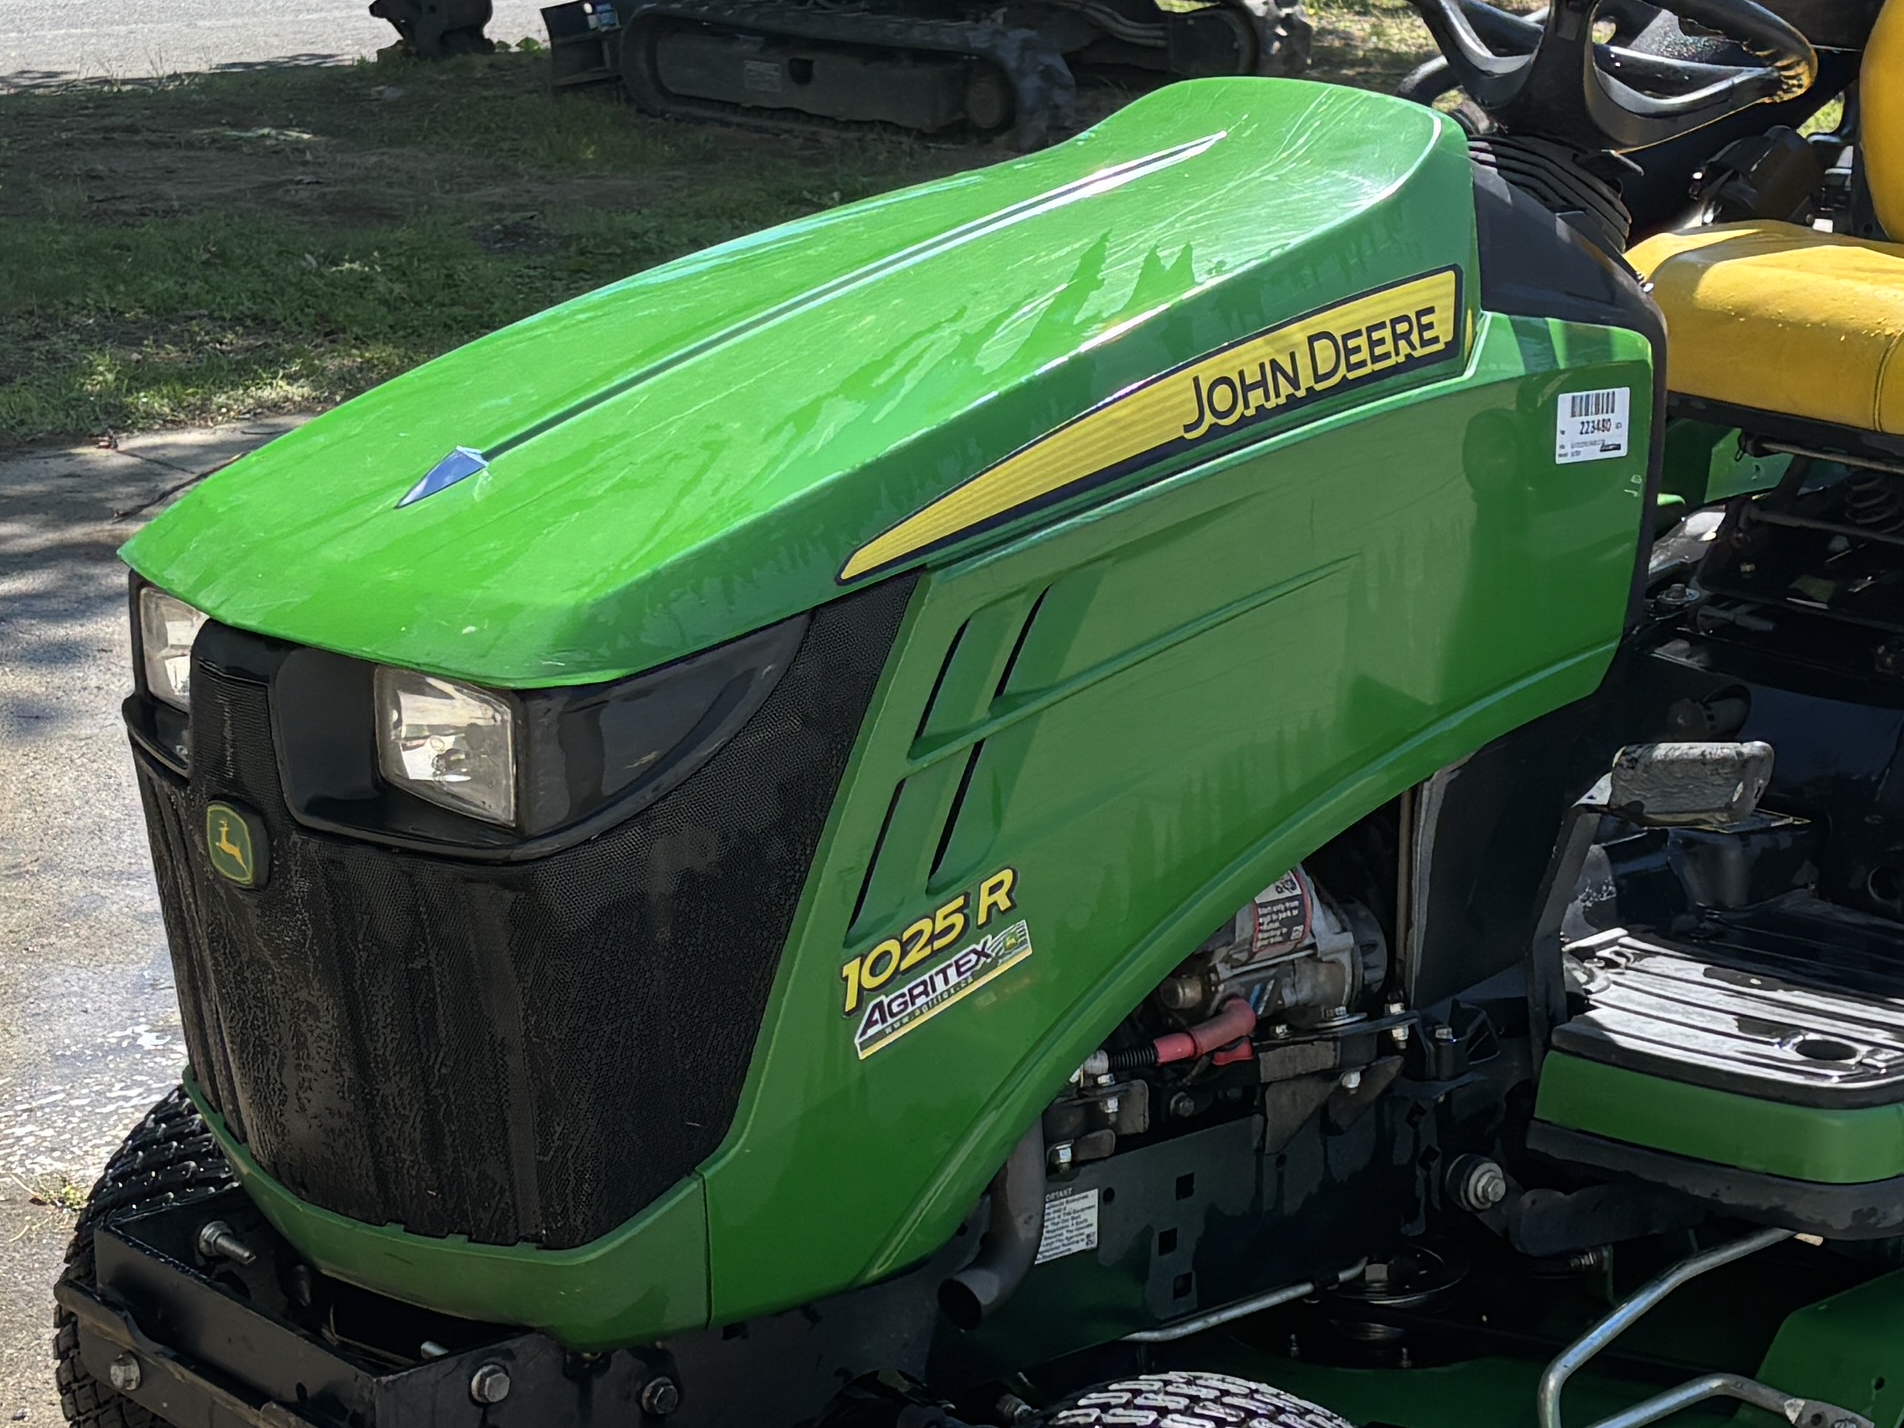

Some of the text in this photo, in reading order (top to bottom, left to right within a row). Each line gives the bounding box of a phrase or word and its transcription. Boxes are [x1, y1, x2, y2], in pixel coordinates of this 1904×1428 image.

[1183, 305, 1441, 435] JOHN DEERE
[842, 868, 1014, 1013] 1025 R
[858, 937, 994, 1040] AGRITEX
